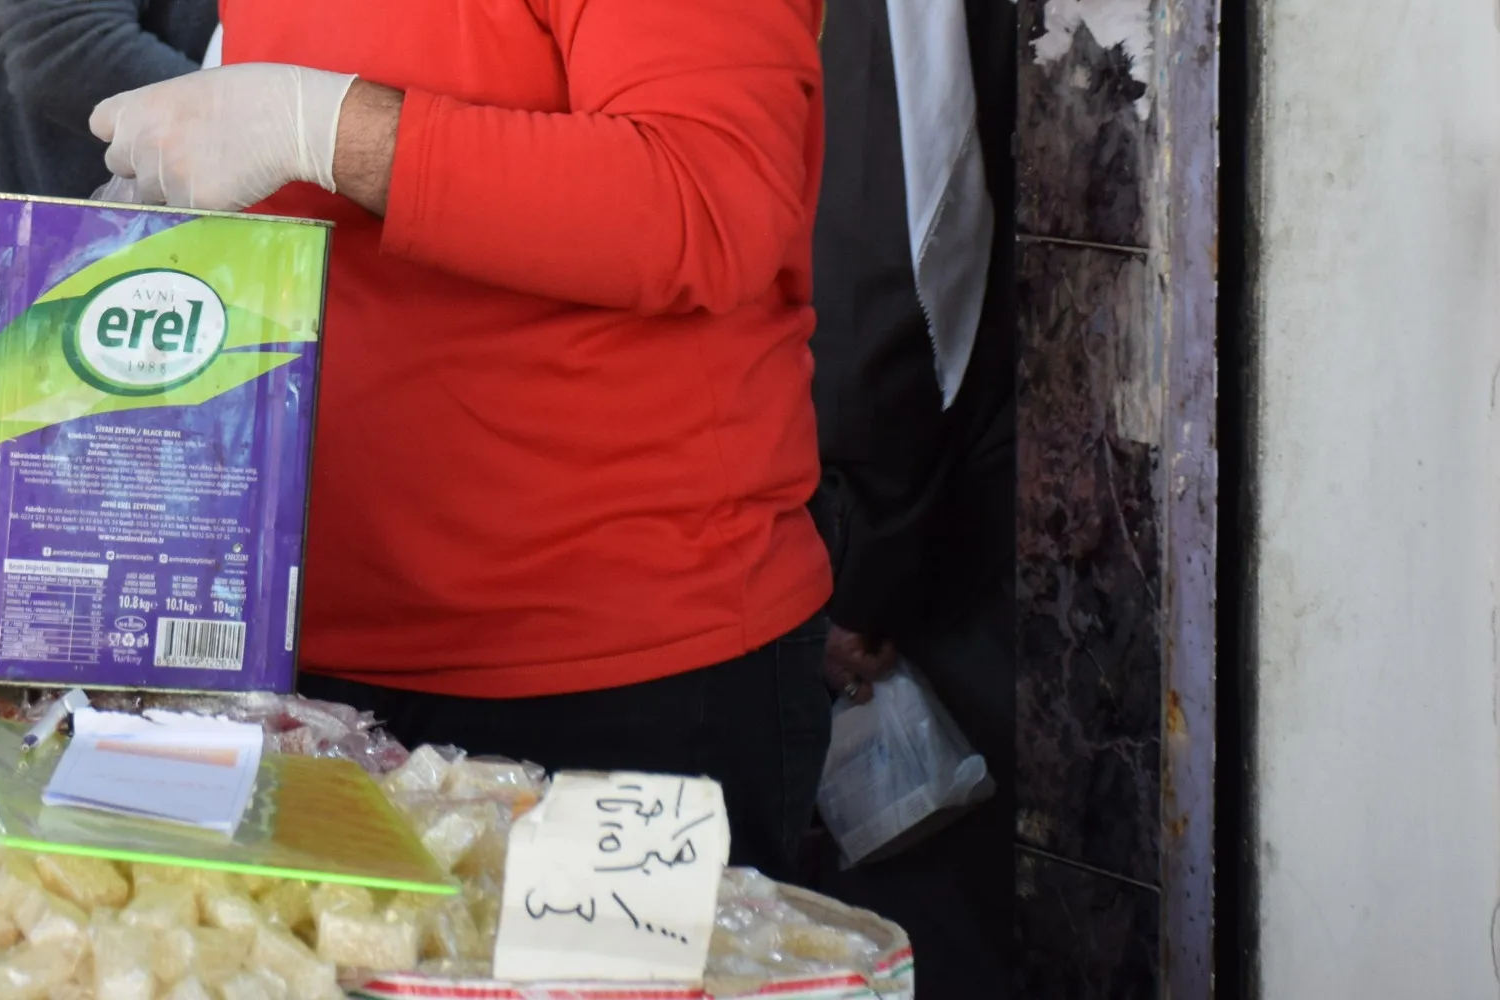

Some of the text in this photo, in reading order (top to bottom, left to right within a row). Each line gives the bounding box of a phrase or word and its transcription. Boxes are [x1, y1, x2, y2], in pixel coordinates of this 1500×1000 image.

[97, 300, 203, 353] erel
[127, 361, 168, 375] 1988
[119, 595, 139, 609] 10.8
[165, 598, 183, 612] 10.1
[212, 601, 224, 613] 10
